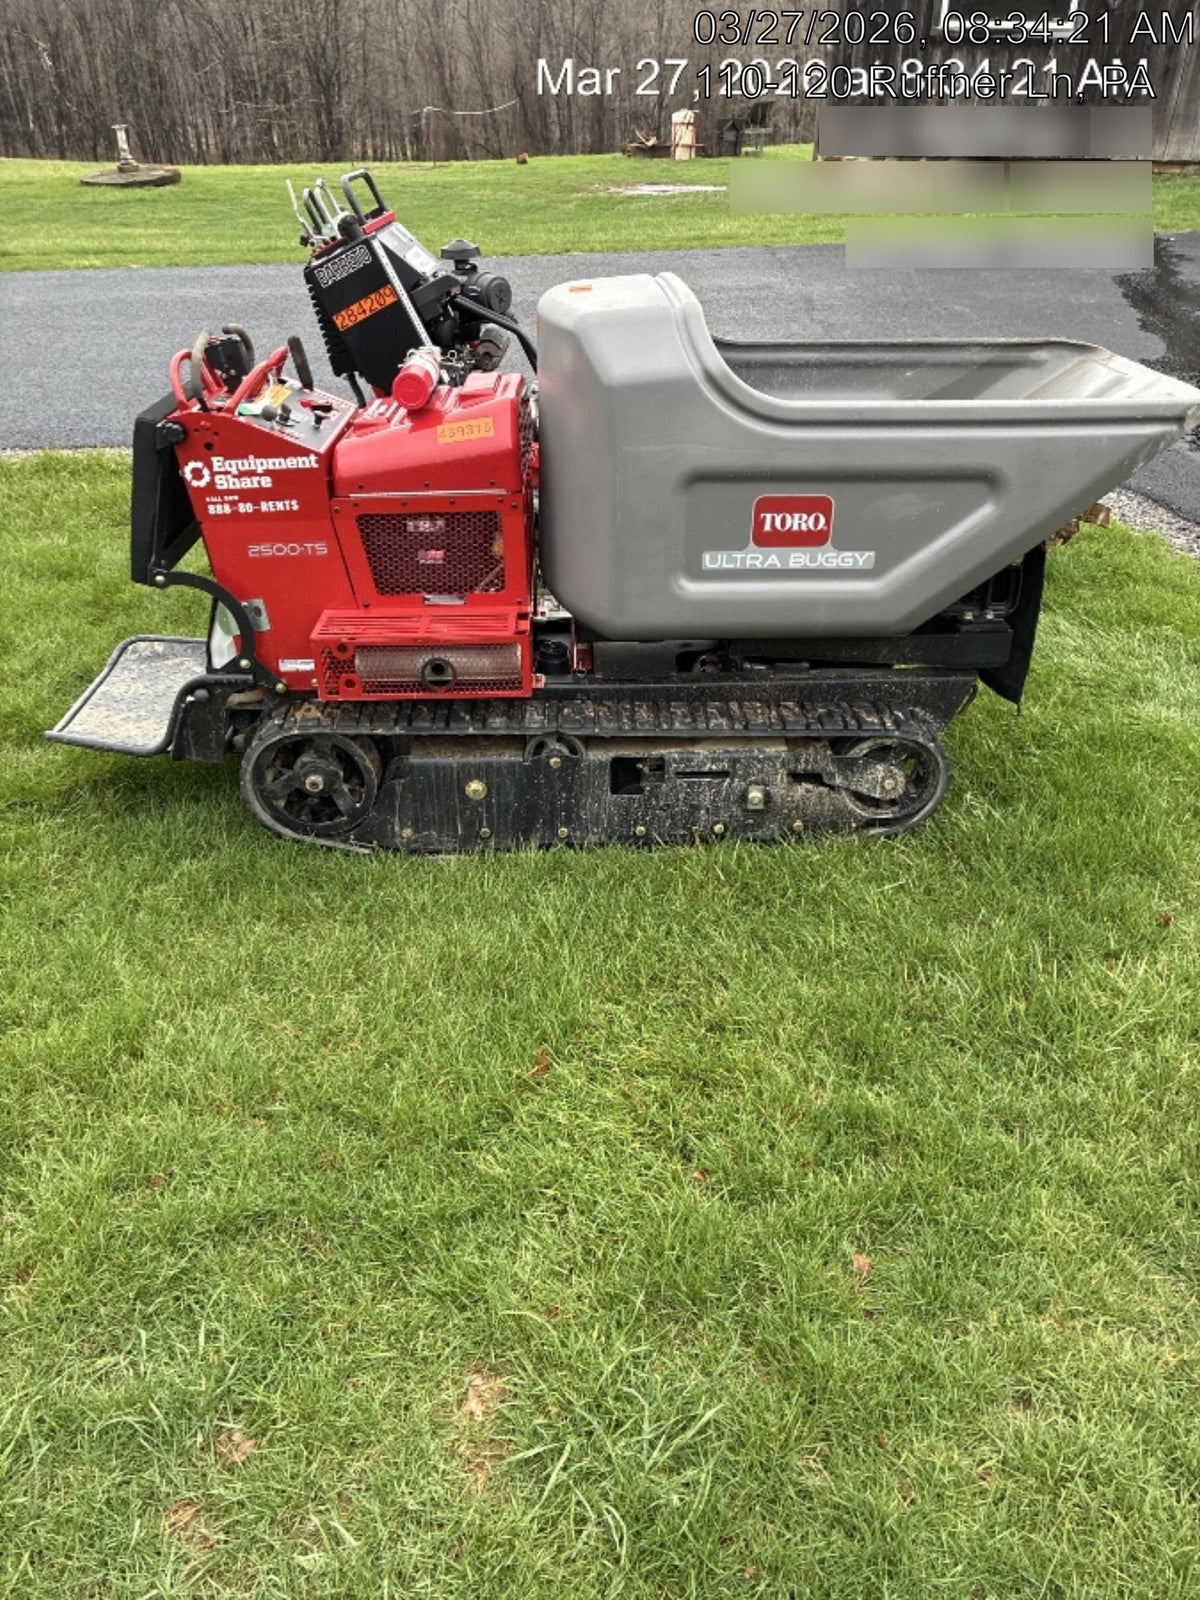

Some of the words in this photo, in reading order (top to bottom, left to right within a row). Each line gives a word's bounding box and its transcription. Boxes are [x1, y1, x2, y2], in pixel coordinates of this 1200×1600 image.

[211, 453, 319, 474] Equipment
[214, 474, 273, 490] Share
[207, 499, 299, 515] 888-80-RENTS
[760, 511, 827, 533] TORO
[704, 553, 782, 568] ULTRA
[789, 551, 872, 568] BUGGY
